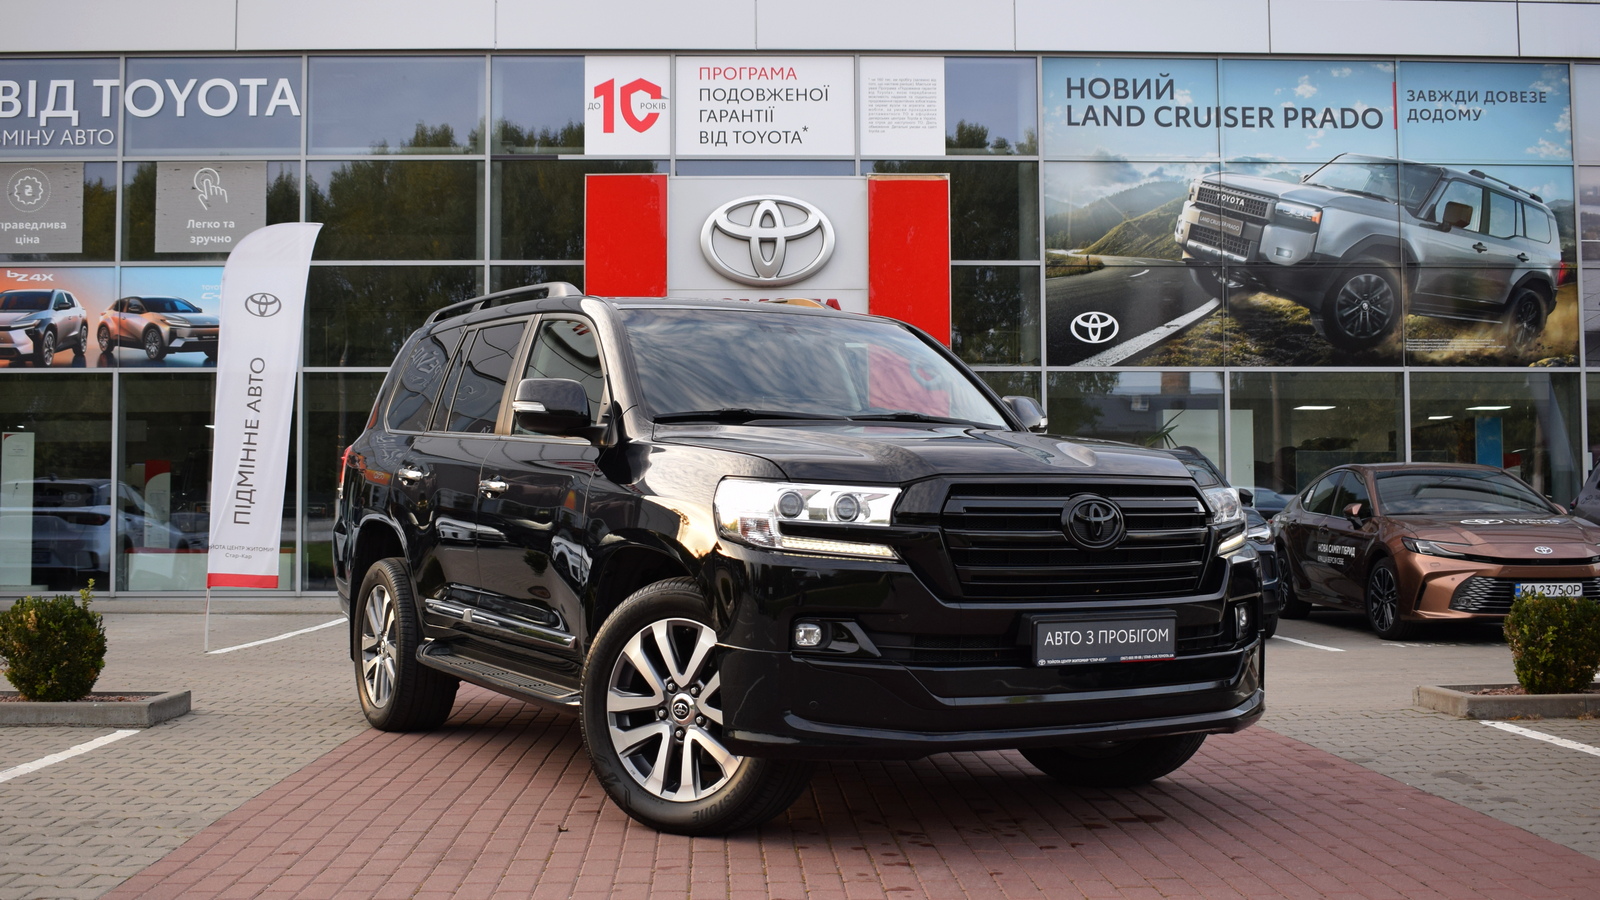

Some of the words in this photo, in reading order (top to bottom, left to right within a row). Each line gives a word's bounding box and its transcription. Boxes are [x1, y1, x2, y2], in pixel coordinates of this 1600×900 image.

[699, 66, 798, 80] ПРОГРАМА
[1066, 72, 1175, 100] НОВИЙ
[699, 84, 830, 104] ПОДОВЖЕНОЇ
[1407, 90, 1479, 105] ЗАВЖДИ
[1484, 91, 1547, 105] ДОВЕЗЕ
[0, 80, 79, 126] ВІД
[93, 78, 301, 118] TOYOTA
[588, 102, 601, 110] ДО
[594, 78, 662, 133] 10
[640, 102, 667, 110] РОКІВ
[699, 106, 775, 123] ГАРАНТІЇ
[1067, 104, 1145, 127] LAND
[1154, 105, 1275, 128] CRUISER
[1284, 107, 1383, 129] PRADO
[1407, 108, 1482, 123] ДОДОМУ
[0, 129, 55, 146] МІНУ
[60, 128, 114, 146] АВТО
[699, 131, 728, 147] ВІД
[1216, 193, 1245, 206] TOYOTA
[186, 219, 220, 229] Легко
[223, 221, 235, 229] та
[15, 234, 40, 245] ціна
[190, 235, 232, 246] зручно
[233, 419, 259, 525] ПІДМІННЕ
[246, 357, 265, 413] АВТО
[1540, 585, 1562, 596] 2375
[1044, 630, 1082, 646] АВТО
[1086, 630, 1094, 645] З
[1098, 628, 1169, 644] ПРОБІГОМ
